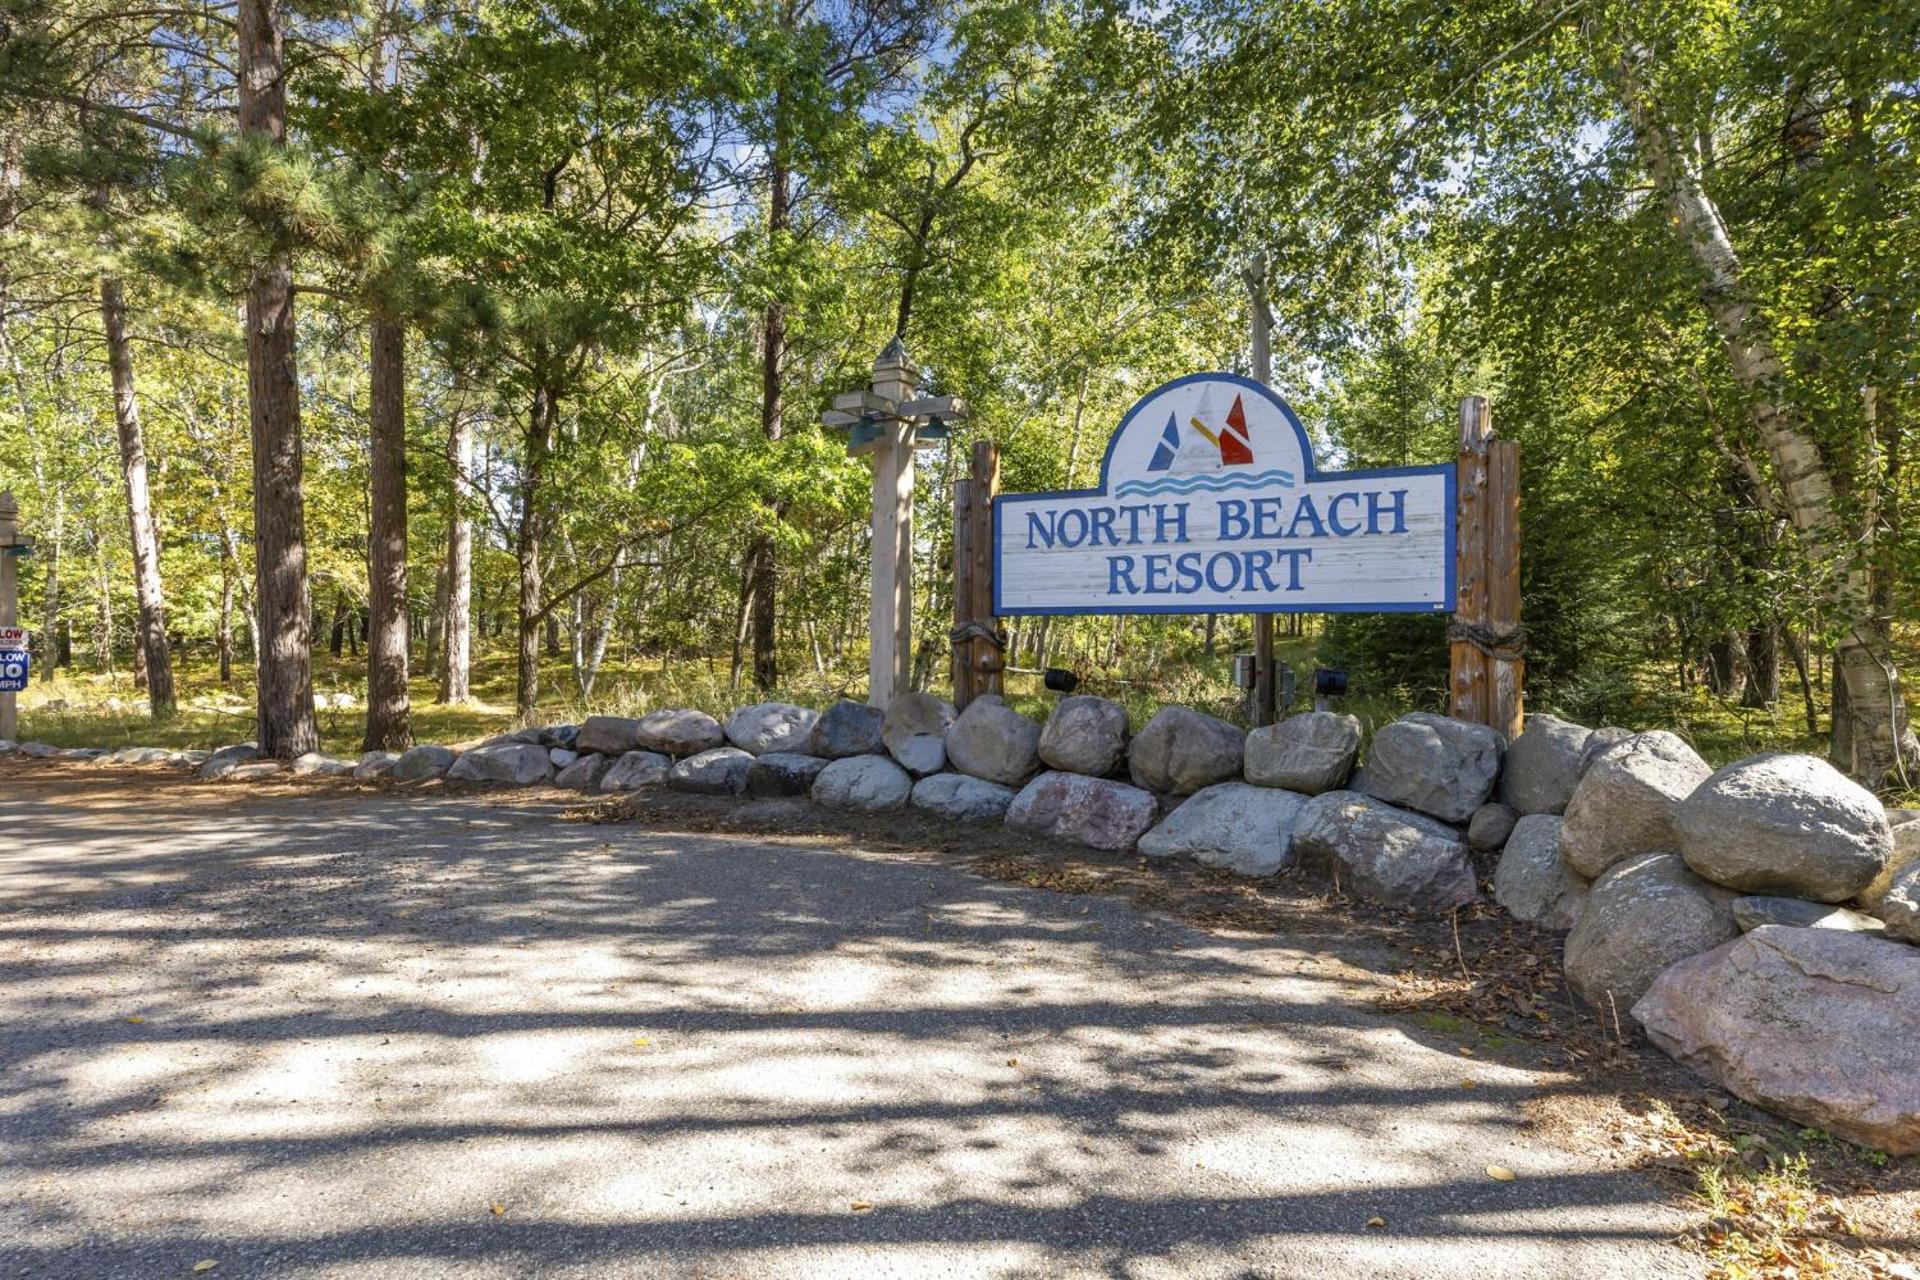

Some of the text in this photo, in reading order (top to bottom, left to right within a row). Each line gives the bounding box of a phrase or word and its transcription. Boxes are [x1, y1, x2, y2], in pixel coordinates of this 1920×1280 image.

[1025, 490, 1408, 549] NORTH BEACH
[1107, 548, 1312, 595] RESORT
[0, 629, 23, 639] LOW
[0, 653, 25, 661] LOW
